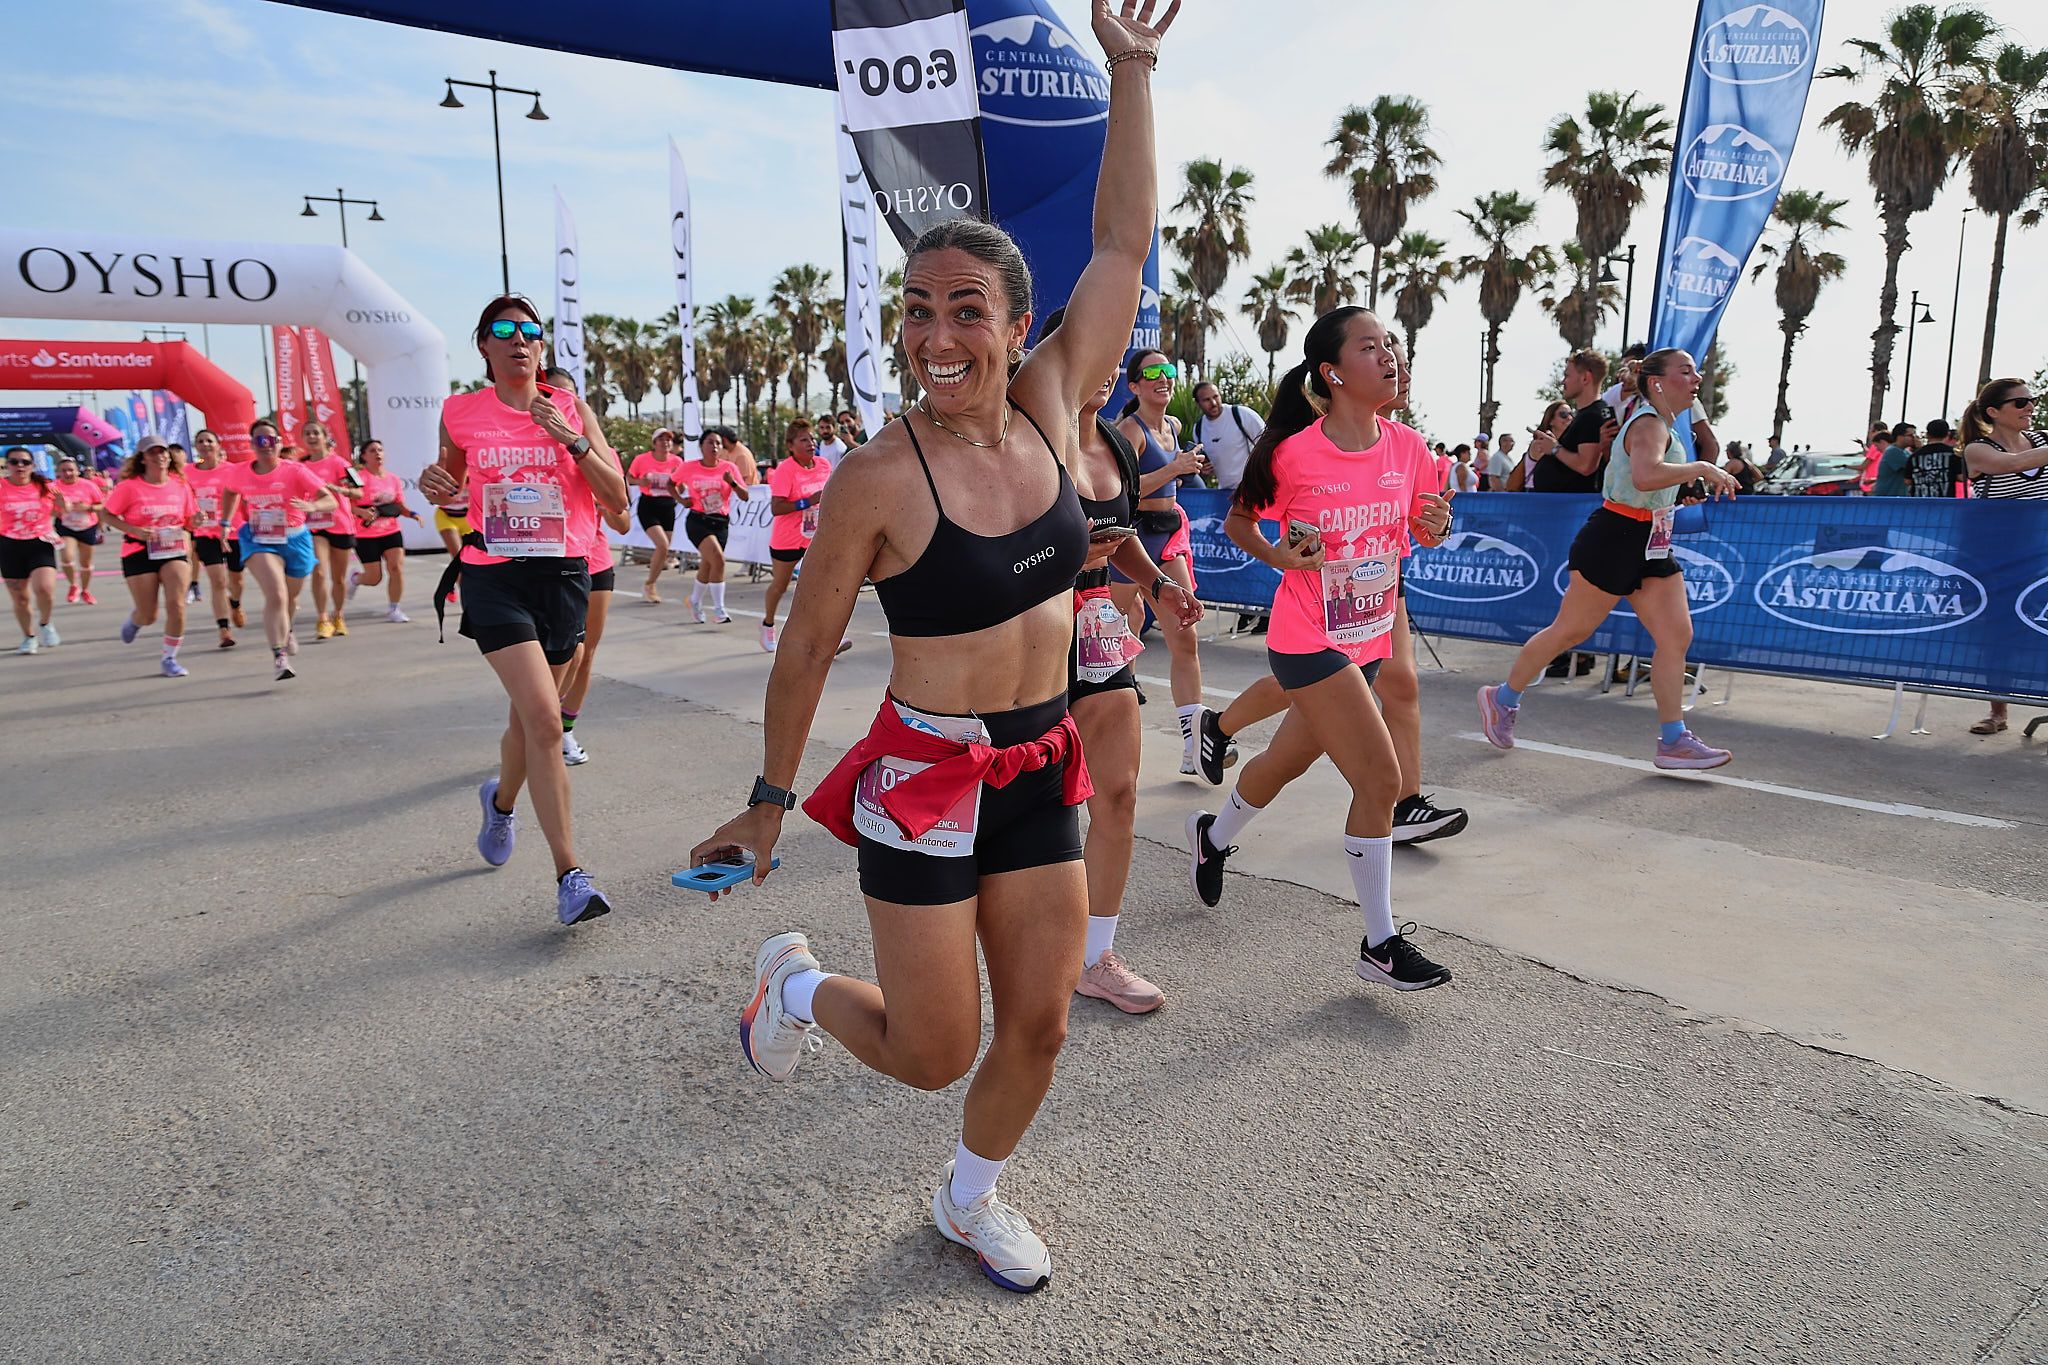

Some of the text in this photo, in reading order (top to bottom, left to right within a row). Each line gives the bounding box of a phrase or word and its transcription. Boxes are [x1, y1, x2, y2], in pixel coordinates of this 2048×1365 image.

[985, 50, 1052, 64] CENTRAL
[1704, 34, 1800, 65] ASTURIANA
[977, 67, 1109, 101] STURIANA
[19, 247, 278, 302] OYSHO
[346, 309, 411, 324] OYSHO
[57, 352, 153, 368] Santander
[477, 446, 557, 469] CARRERA
[1312, 481, 1350, 495] OYSHO
[509, 516, 541, 529] 016
[1094, 517, 1117, 526] OYSHO
[1319, 500, 1401, 533] CARRERA
[1013, 546, 1055, 574] OYSHO
[1191, 543, 1248, 562] TURIANA
[1405, 554, 1525, 588] ASTURIANA
[1806, 574, 1962, 589] CENTRAL LECHERA
[1355, 592, 1384, 611] 016
[1767, 574, 1966, 616] ASTURIANA
[1101, 637, 1121, 651] 016
[1336, 630, 1364, 640] OYSHO
[859, 813, 885, 834] OYSHO
